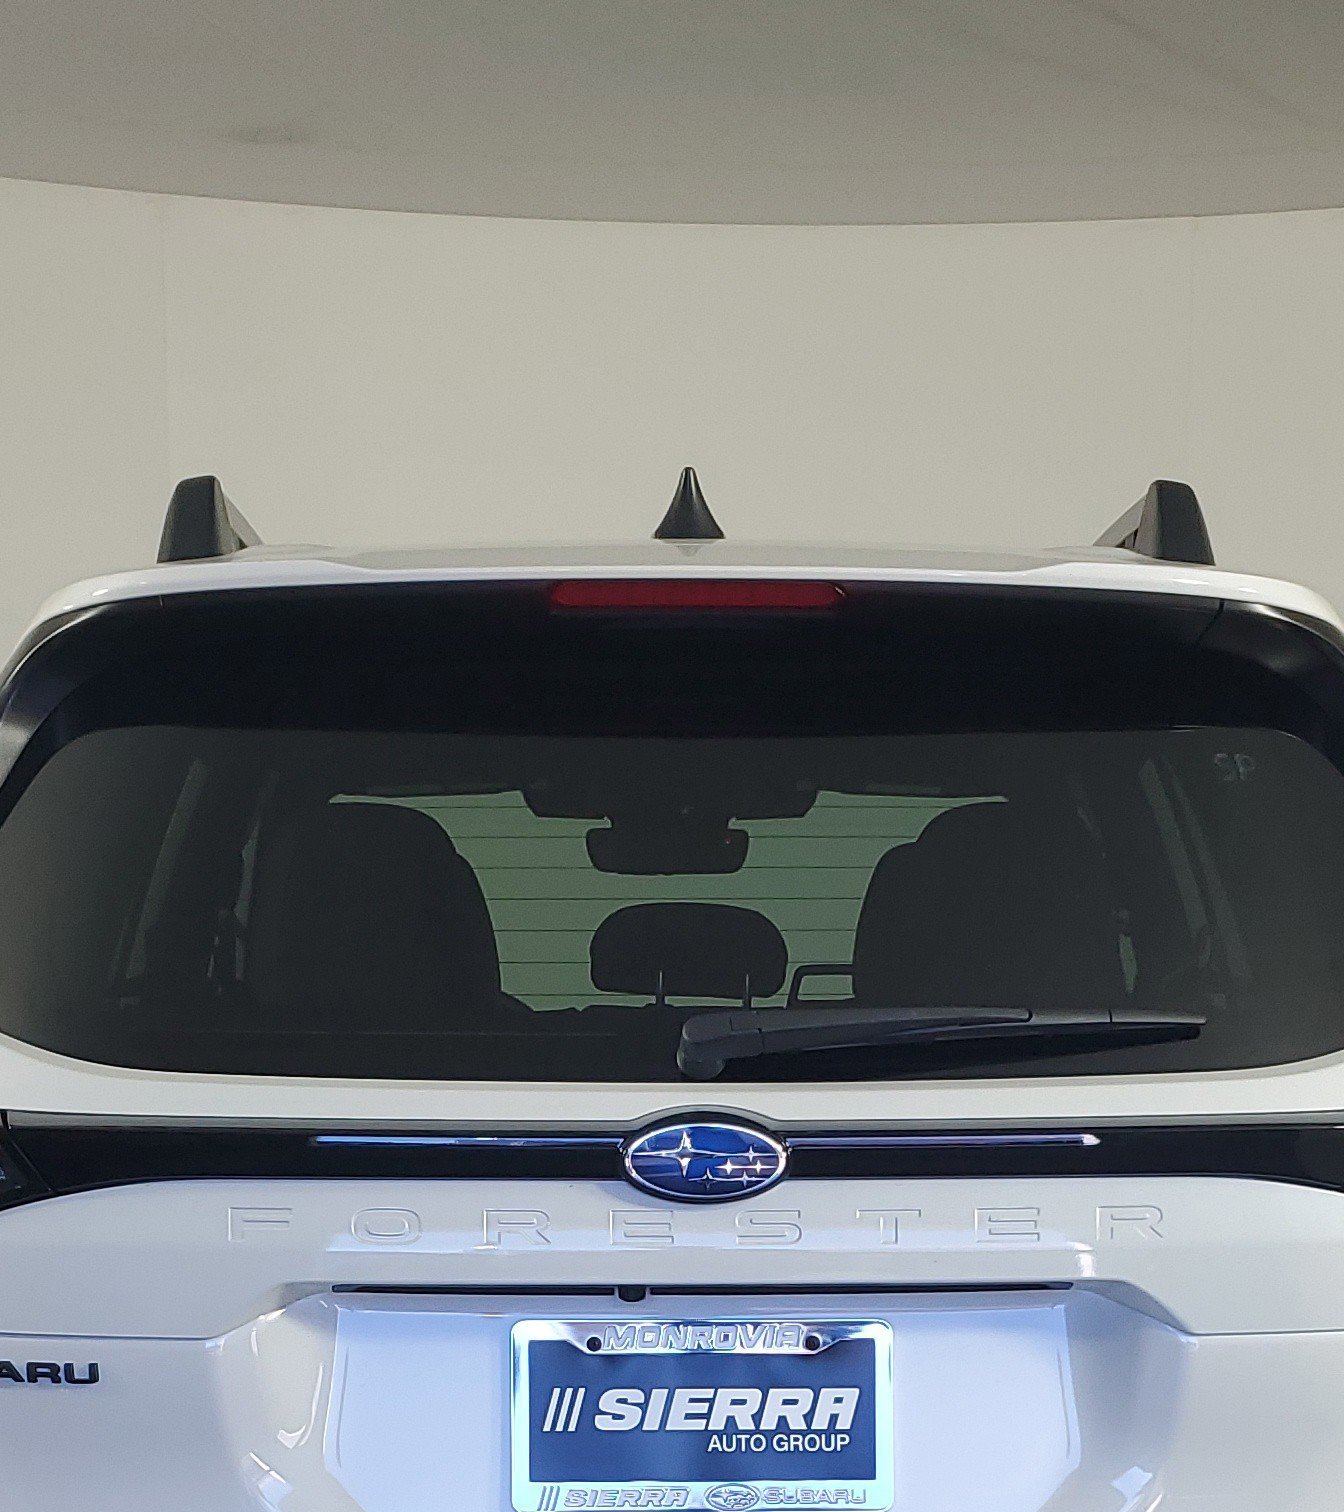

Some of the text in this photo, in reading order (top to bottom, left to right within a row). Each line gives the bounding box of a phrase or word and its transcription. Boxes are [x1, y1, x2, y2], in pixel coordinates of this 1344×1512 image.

[226, 1205, 1164, 1246] FORESTER
[601, 1323, 801, 1351] MONROVIA
[594, 1387, 861, 1432] SIERRA
[707, 1434, 851, 1453] AUTO GROUP
[563, 1486, 867, 1508] SIERRA SUBARU
